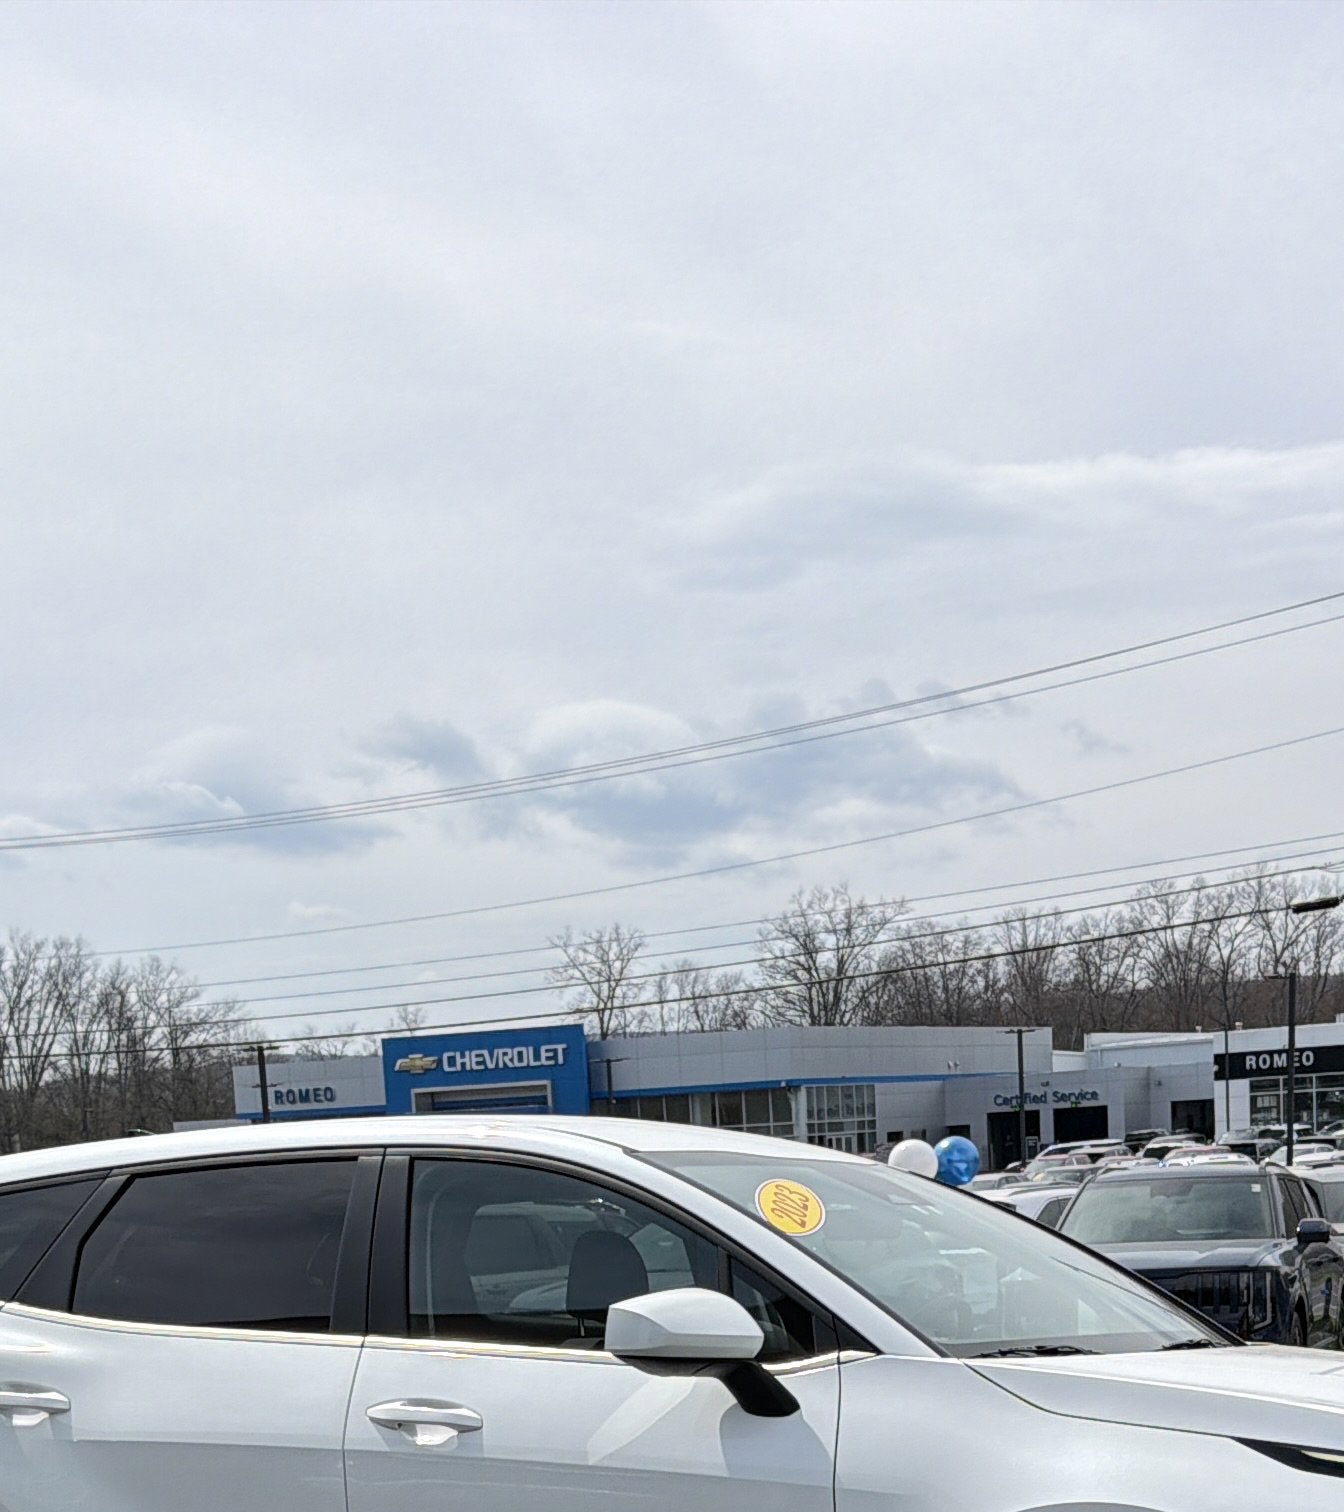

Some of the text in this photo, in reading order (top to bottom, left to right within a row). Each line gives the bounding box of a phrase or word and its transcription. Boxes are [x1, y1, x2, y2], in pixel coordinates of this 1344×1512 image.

[442, 1044, 567, 1072] CHEVROLET
[1245, 1050, 1315, 1070] ROMEO
[274, 1086, 336, 1105] ROMEO
[1052, 1089, 1099, 1103] Service
[770, 1184, 810, 1229] 2023
